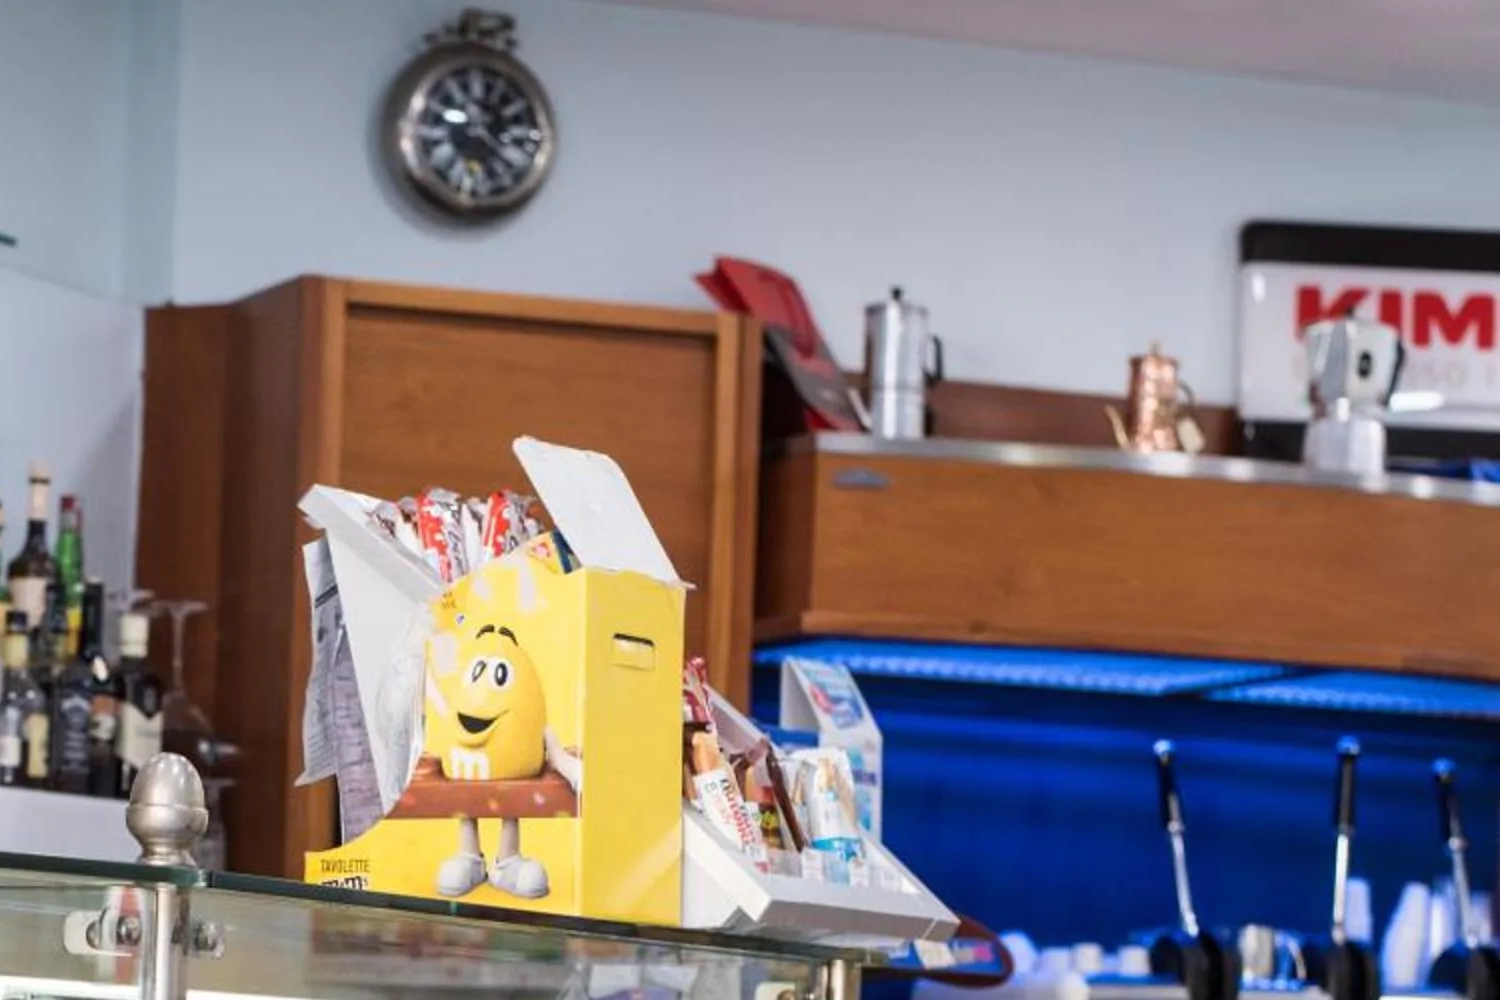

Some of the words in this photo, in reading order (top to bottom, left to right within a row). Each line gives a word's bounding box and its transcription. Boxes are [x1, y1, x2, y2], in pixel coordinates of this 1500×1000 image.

[1297, 285, 1495, 349] KIM
[450, 747, 490, 781] m
[320, 859, 370, 873] TAVOLETTE
